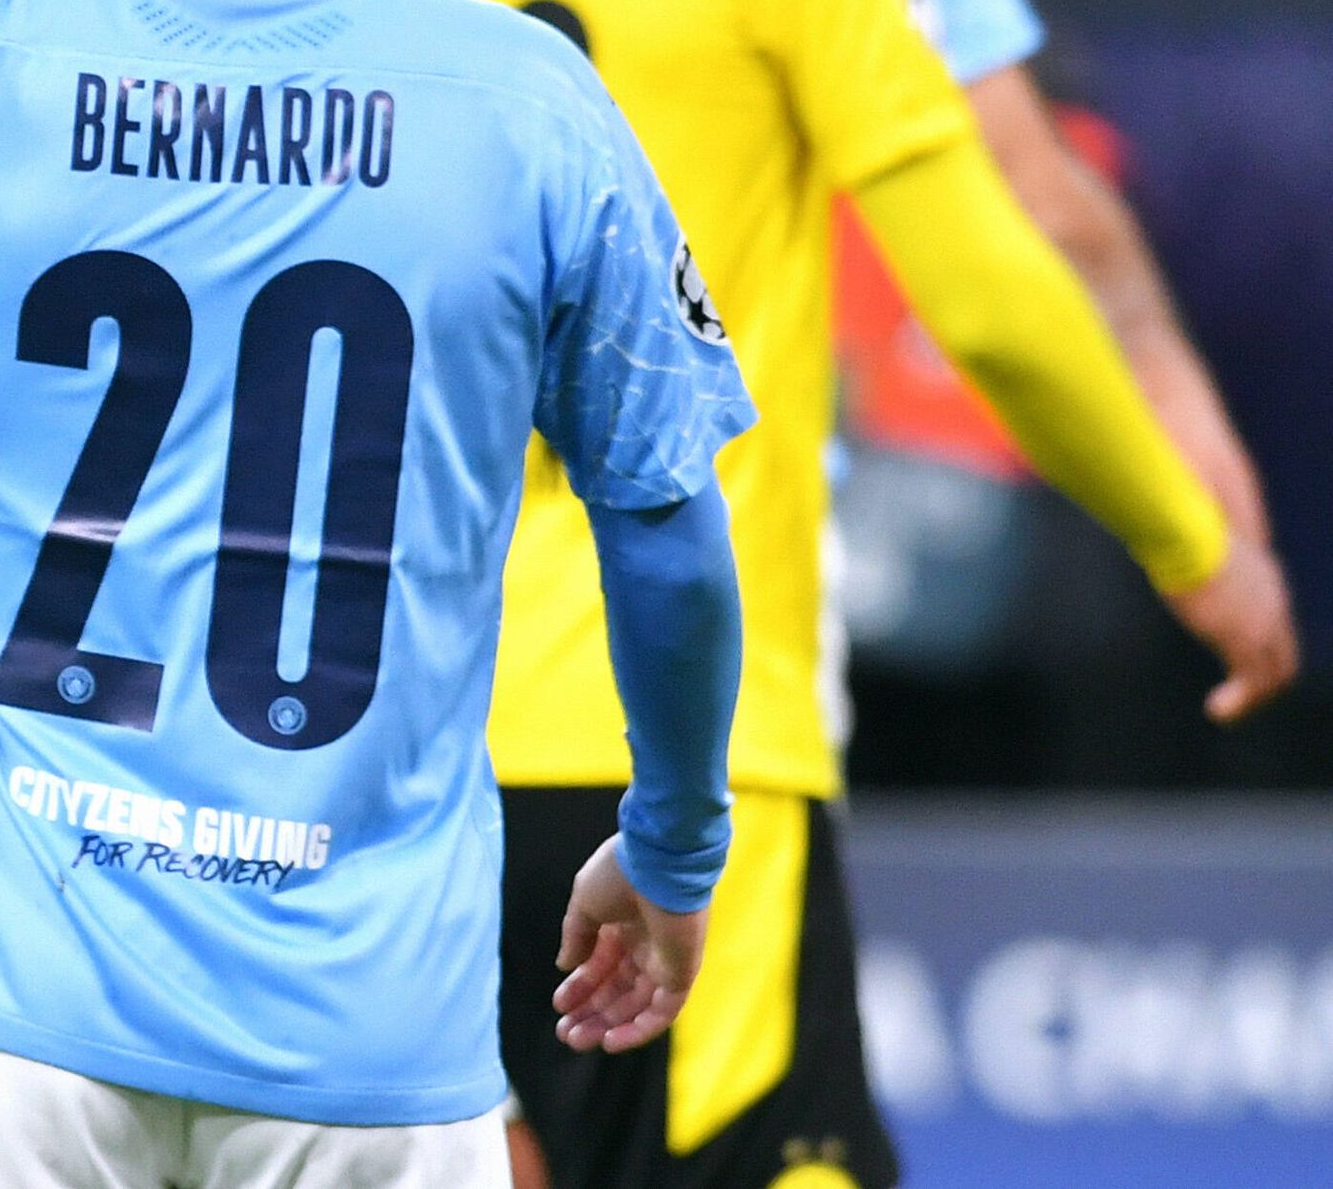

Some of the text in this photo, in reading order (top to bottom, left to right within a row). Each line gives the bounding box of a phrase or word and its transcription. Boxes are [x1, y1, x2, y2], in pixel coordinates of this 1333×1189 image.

[70, 72, 395, 189] BERNARDO
[8, 764, 332, 871] CITYZENS GIVING
[71, 834, 295, 896] FOR RECOVERY
